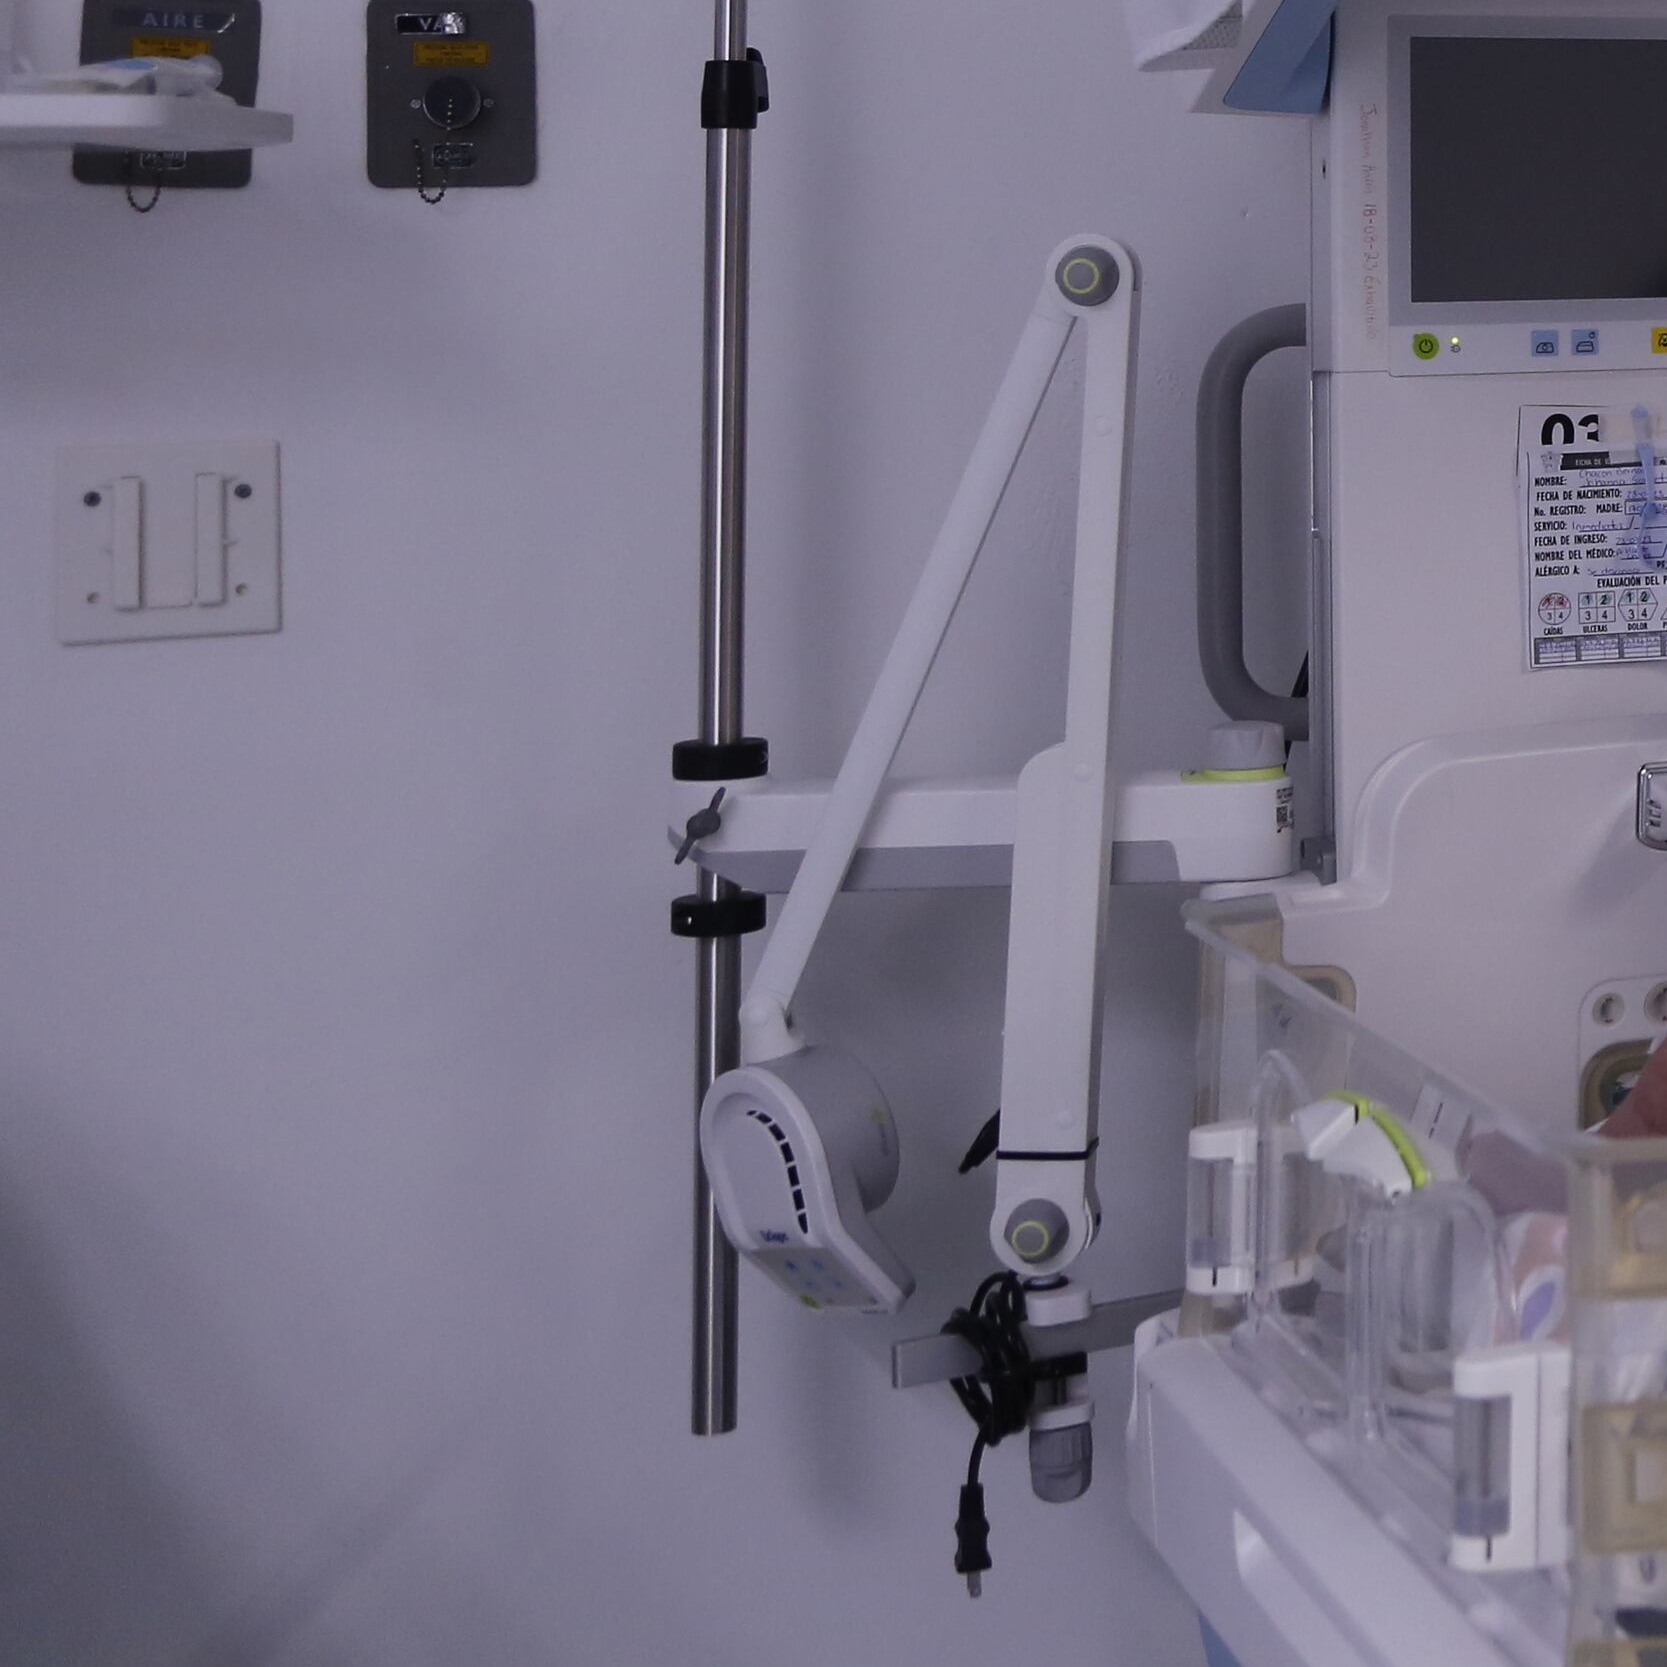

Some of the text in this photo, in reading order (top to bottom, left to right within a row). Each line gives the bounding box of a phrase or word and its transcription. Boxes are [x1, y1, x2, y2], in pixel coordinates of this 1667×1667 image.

[142, 13, 205, 30] AIRE
[1534, 476, 1568, 487] NOMBRE:
[1536, 489, 1560, 502] FECHA
[1563, 490, 1573, 501] DE
[1576, 488, 1622, 500] NACIMIENTO:
[1534, 506, 1546, 516] No.
[1549, 504, 1587, 516] REGISTRO:
[1596, 502, 1623, 514] MADRE:
[1534, 520, 1568, 532] SERVICIO:
[1534, 536, 1557, 547] FECHA
[1560, 535, 1570, 546] DE
[1574, 533, 1608, 545] INGRESO:
[1534, 551, 1565, 562] NOMBRE
[1568, 549, 1582, 561] DEL
[1586, 547, 1617, 559] MÉDICO:
[1535, 564, 1570, 577] ALÉRGICO
[1597, 574, 1641, 588] EVALUACIÓN
[1645, 575, 1660, 585] DEL
[1601, 610, 1608, 620] 4
[1641, 608, 1648, 618] 4
[1544, 626, 1564, 636] CAÍDAS
[1583, 625, 1608, 634] ULCERAS
[1627, 622, 1649, 631] DOLOR
